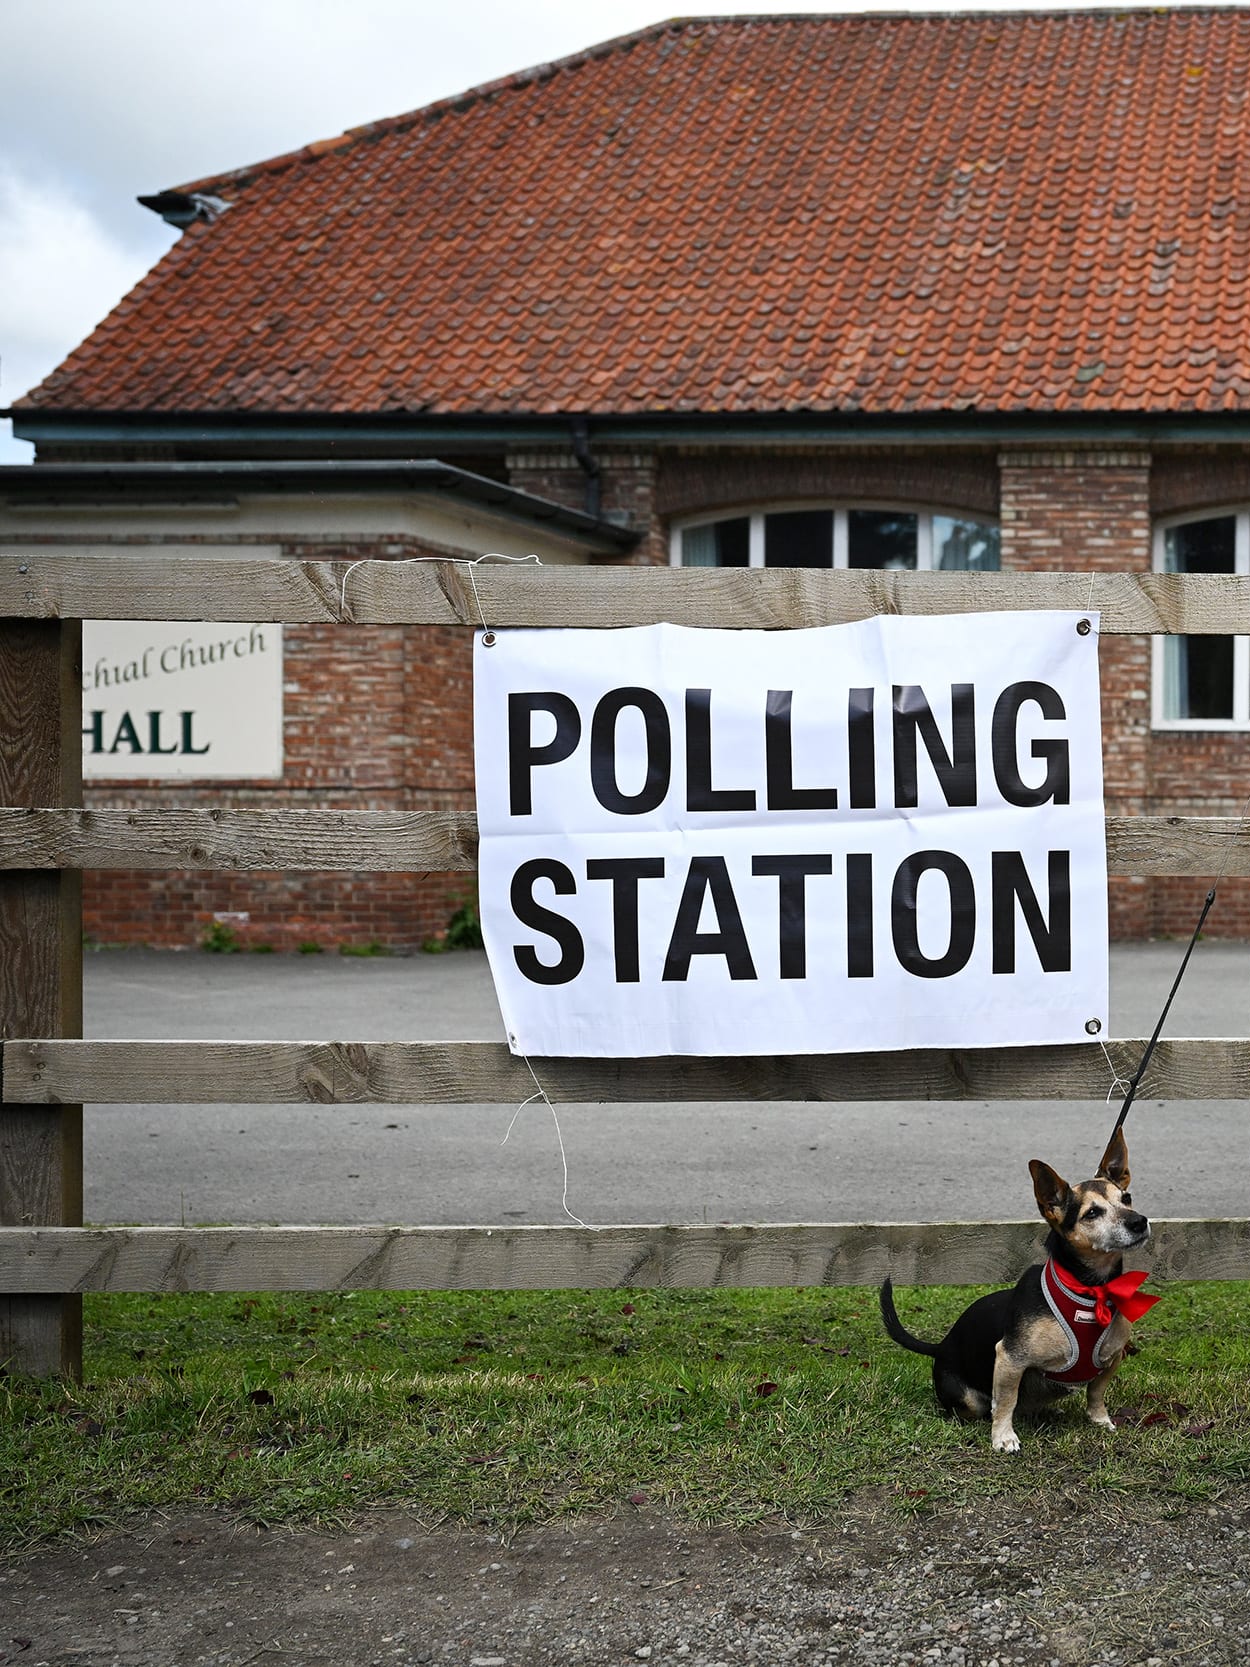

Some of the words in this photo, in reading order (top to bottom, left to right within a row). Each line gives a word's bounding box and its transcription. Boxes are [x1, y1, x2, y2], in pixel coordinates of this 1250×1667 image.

[160, 624, 267, 674] Church
[83, 710, 210, 755] HALL
[508, 681, 1071, 816] POLLING
[510, 849, 1072, 985] STATION
